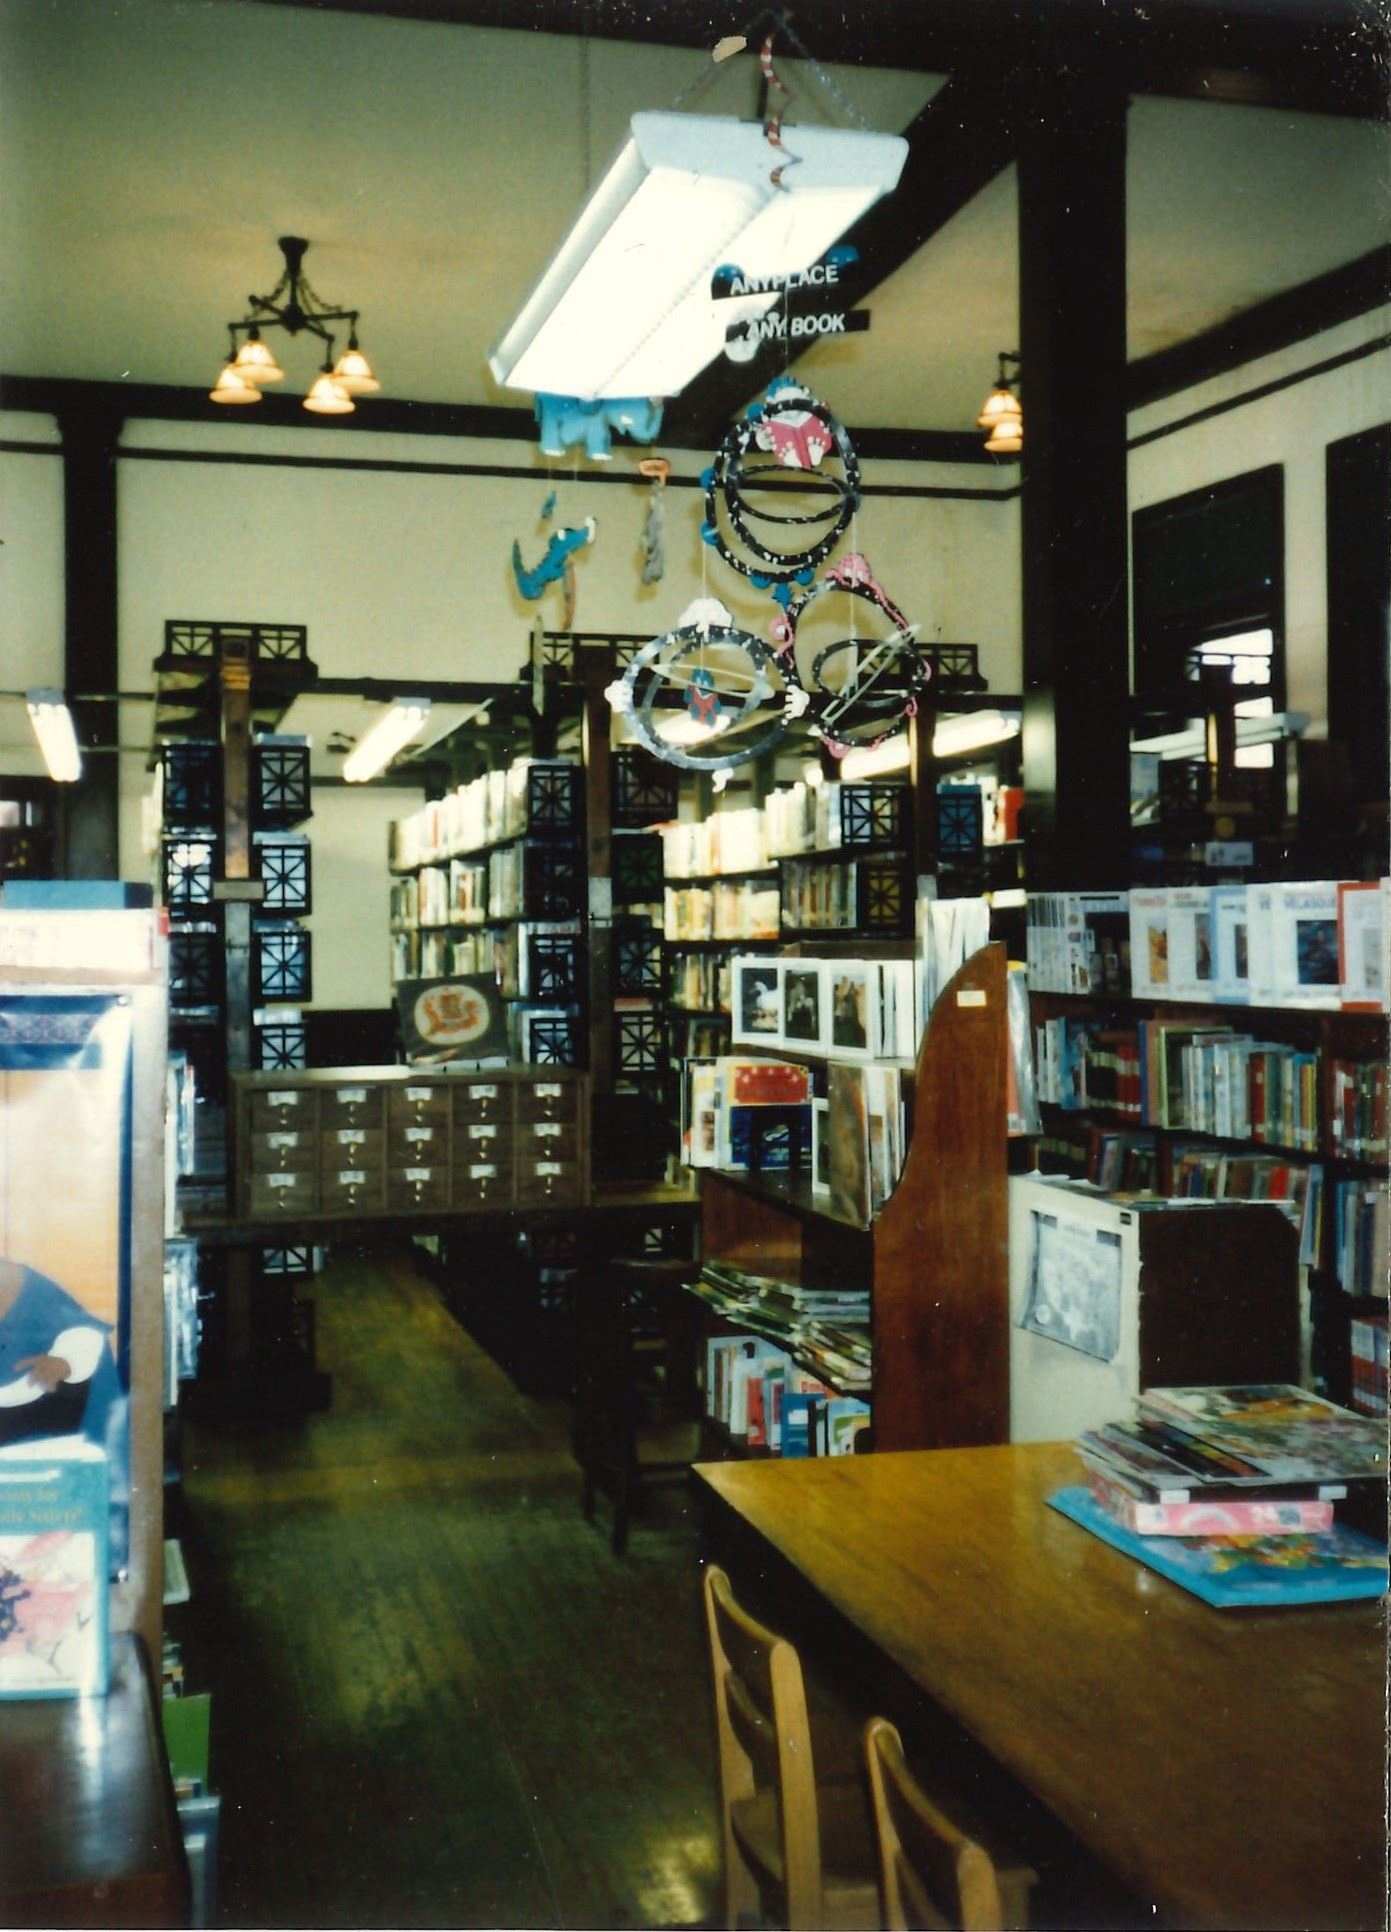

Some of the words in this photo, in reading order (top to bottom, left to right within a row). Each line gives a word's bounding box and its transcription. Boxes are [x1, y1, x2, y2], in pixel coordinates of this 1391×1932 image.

[730, 264, 839, 295] ANYPLACE
[746, 319, 786, 339] ANY
[790, 313, 846, 337] BOOK
